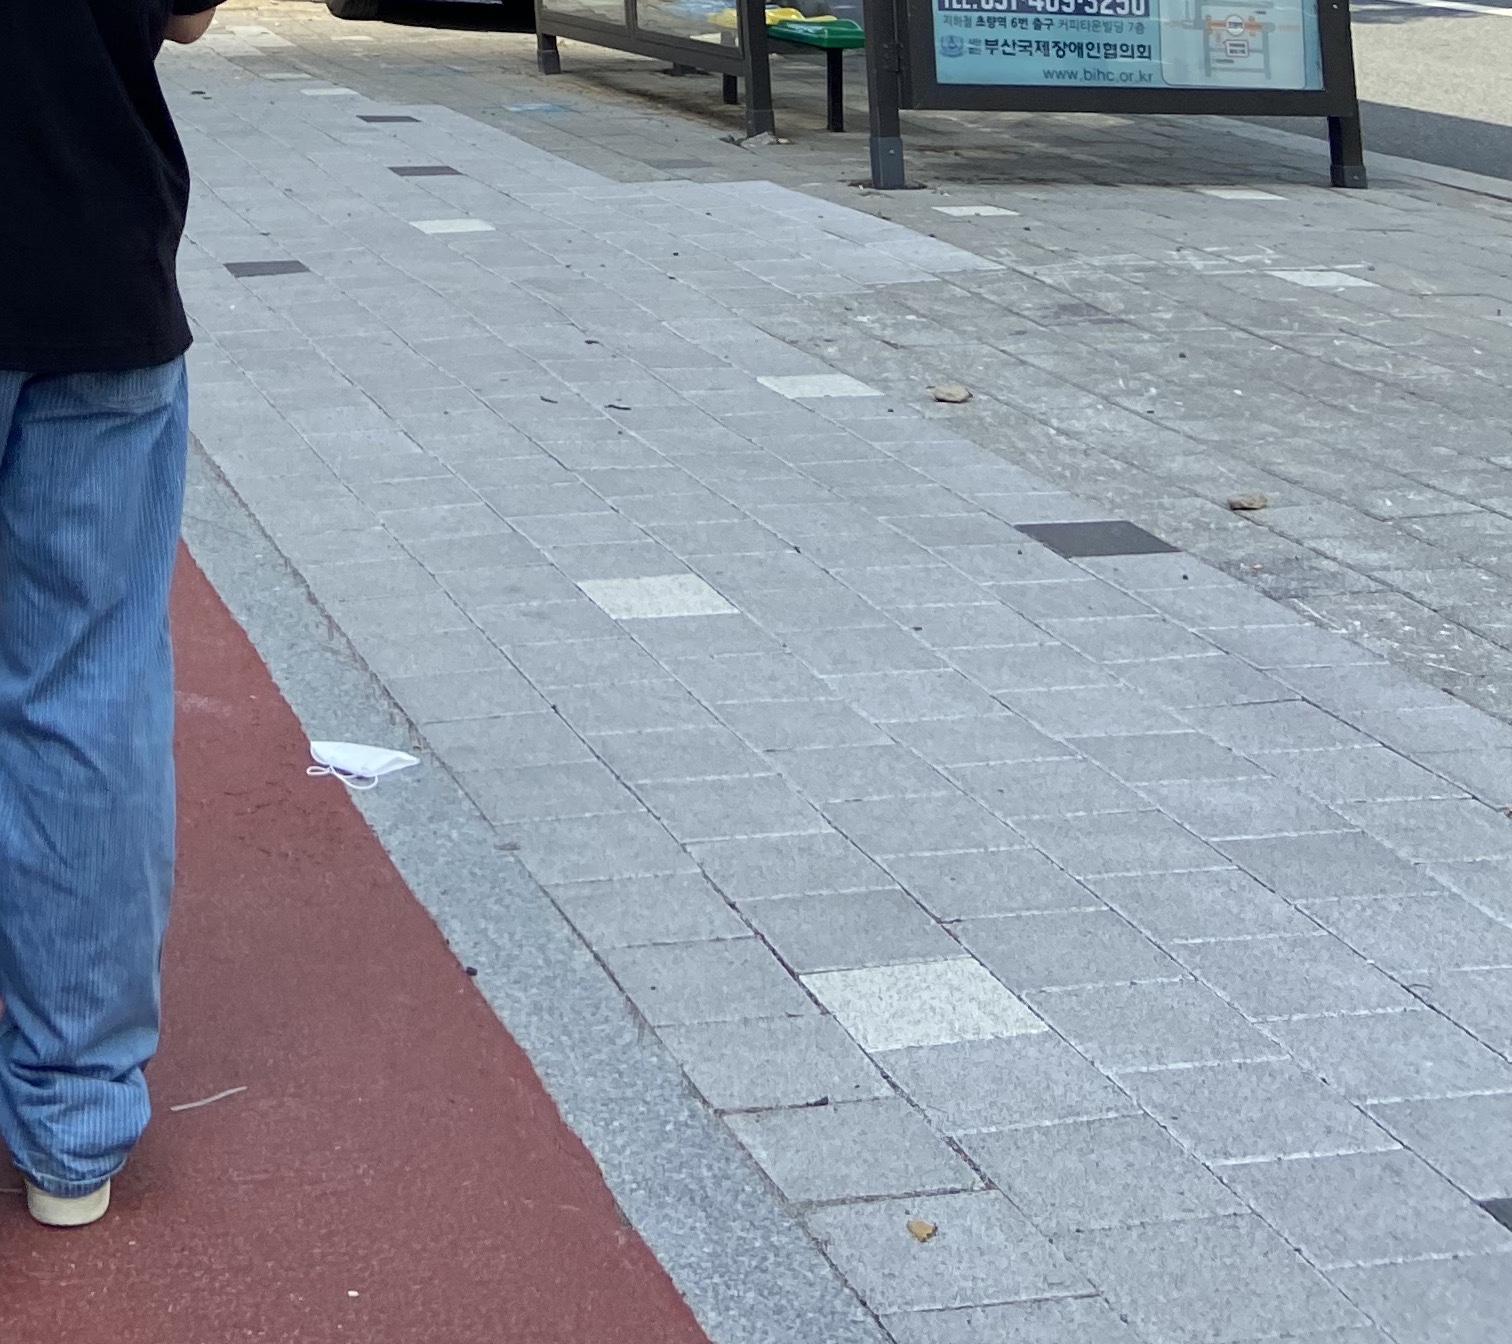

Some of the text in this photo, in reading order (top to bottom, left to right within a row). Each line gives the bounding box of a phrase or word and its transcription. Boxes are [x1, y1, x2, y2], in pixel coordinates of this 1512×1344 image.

[1032, 17, 1054, 31] 출구
[984, 38, 1152, 60] 부산국제장애인협의회
[1043, 67, 1154, 82] www.bihc.or.kr
